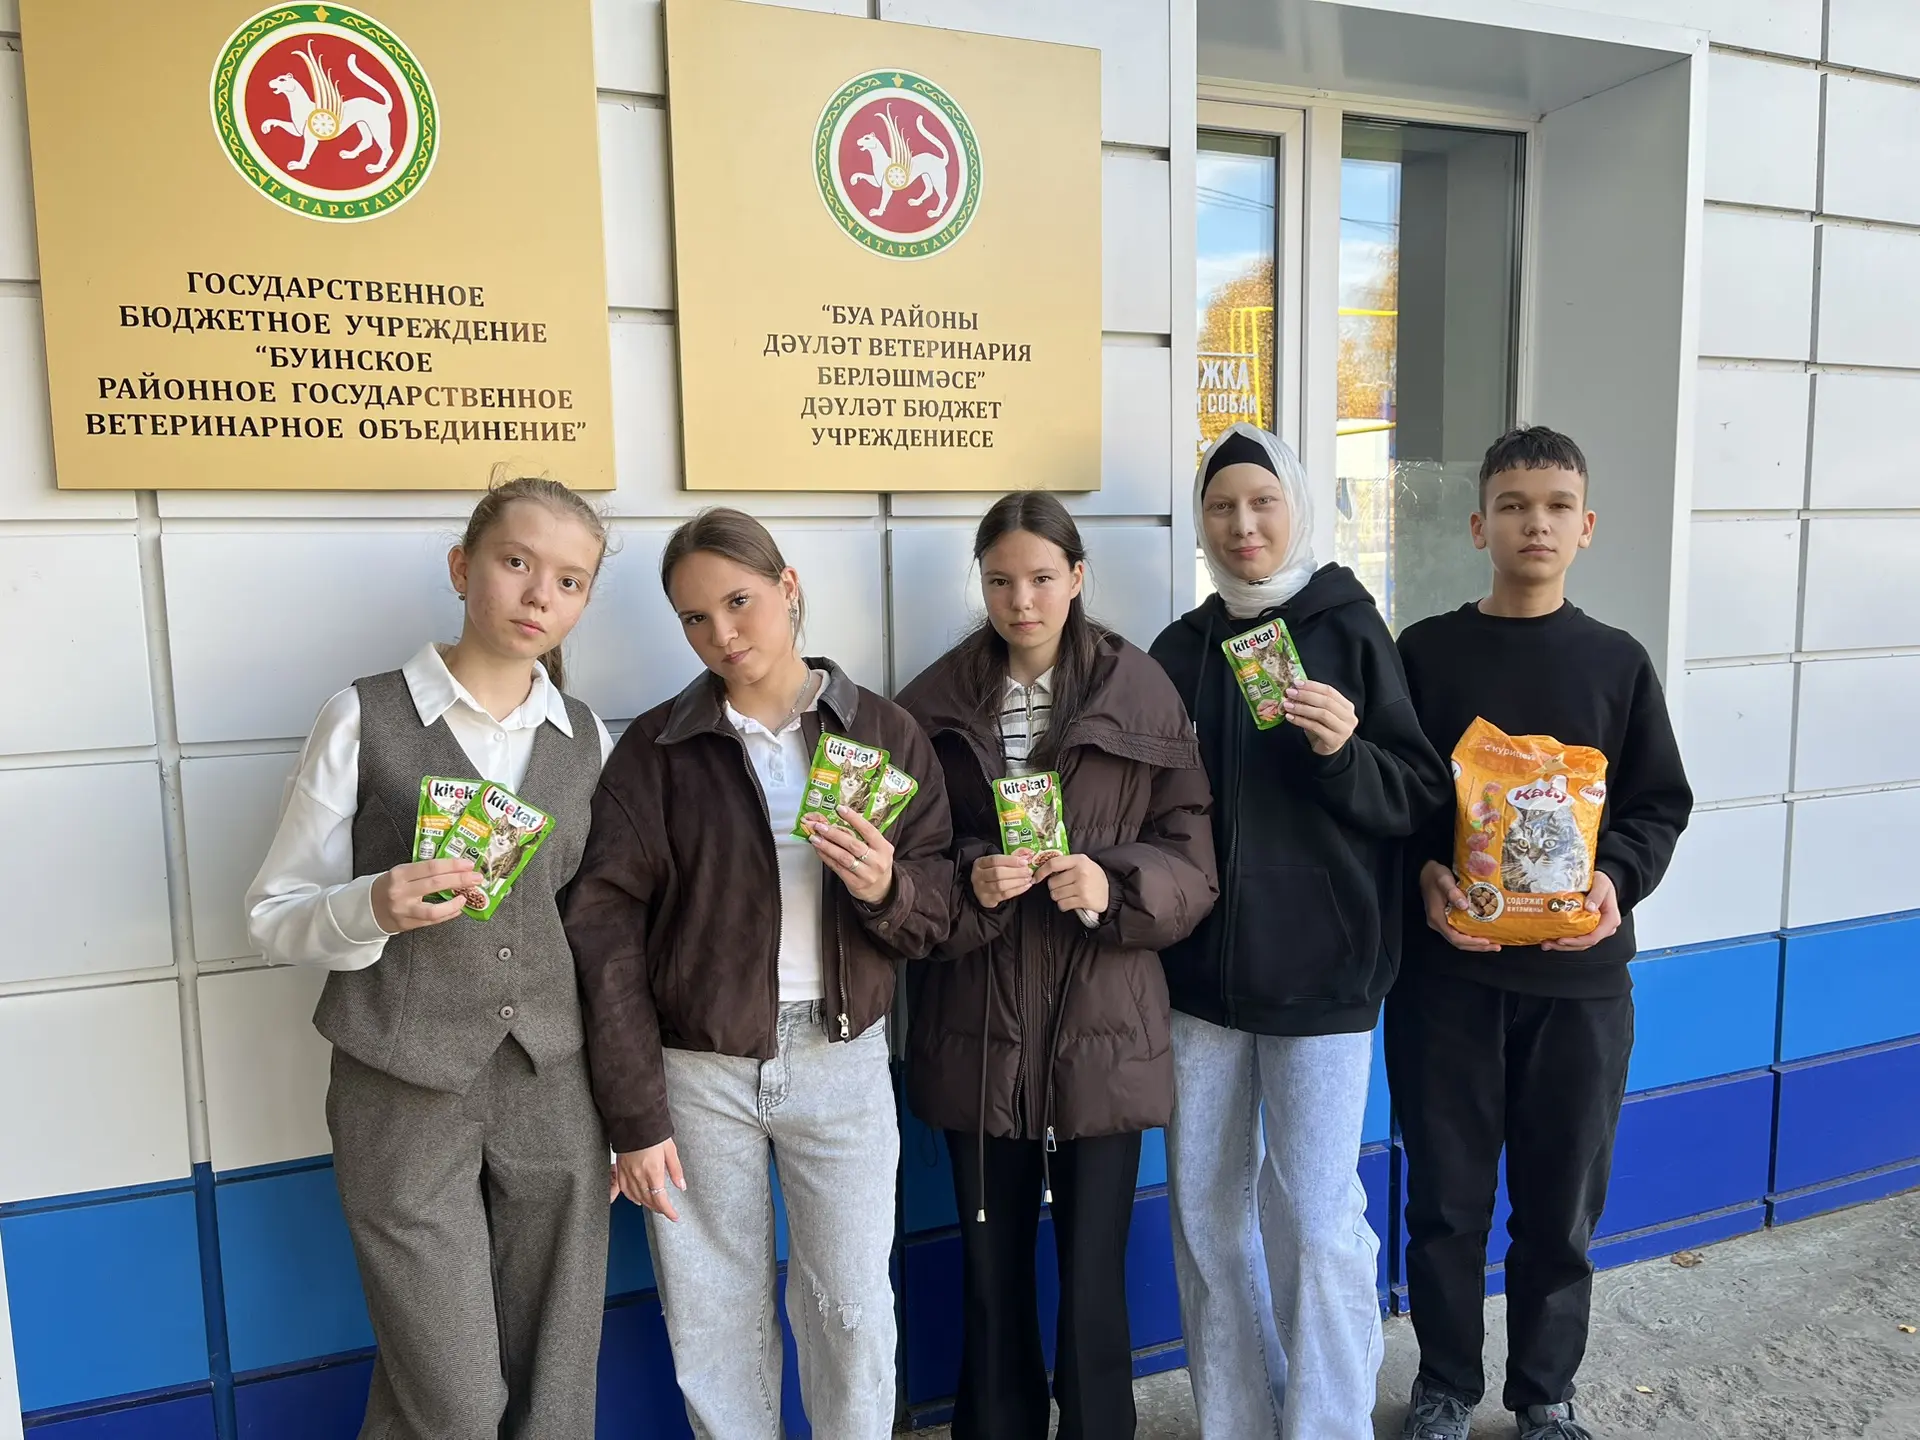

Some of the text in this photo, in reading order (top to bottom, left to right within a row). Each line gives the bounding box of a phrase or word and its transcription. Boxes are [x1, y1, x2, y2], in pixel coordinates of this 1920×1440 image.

[265, 181, 401, 217] ТАТАРСТАН
[854, 225, 952, 256] ТАТАРСТАН
[186, 271, 485, 308] ГОСУДАРСТВЕННОЕ
[118, 305, 547, 344] БЮДЖЕТНОЕ УЧРЕЖДЕНИЕ
[821, 303, 979, 330] “БУА РАЙОНЫ
[255, 345, 433, 373] “БУИНСКОЕ
[763, 334, 1032, 362] ДӘҮЛӘТ ВЕТЕРИНАРИЯ
[1197, 360, 1250, 391] ЖКА
[98, 371, 573, 410] РАЙОННОЕ ГОСУДАРСТВЕННОЕ
[801, 397, 1002, 421] ДӘҮЛӘТ БЮДЖЕТ
[86, 413, 586, 444] ВЕТЕРИНАРНОЕ ОБЪЕДИНЕНИЕ”
[811, 428, 994, 450] УЧРЕЖДЕНИЕСЕ
[1233, 628, 1275, 653] kitekat
[828, 740, 874, 765] kitekat
[434, 782, 480, 800] kitek
[1004, 778, 1046, 795] kitekat
[487, 790, 538, 828] kitekat
[1506, 897, 1544, 905] СОДЕРЖИТ
